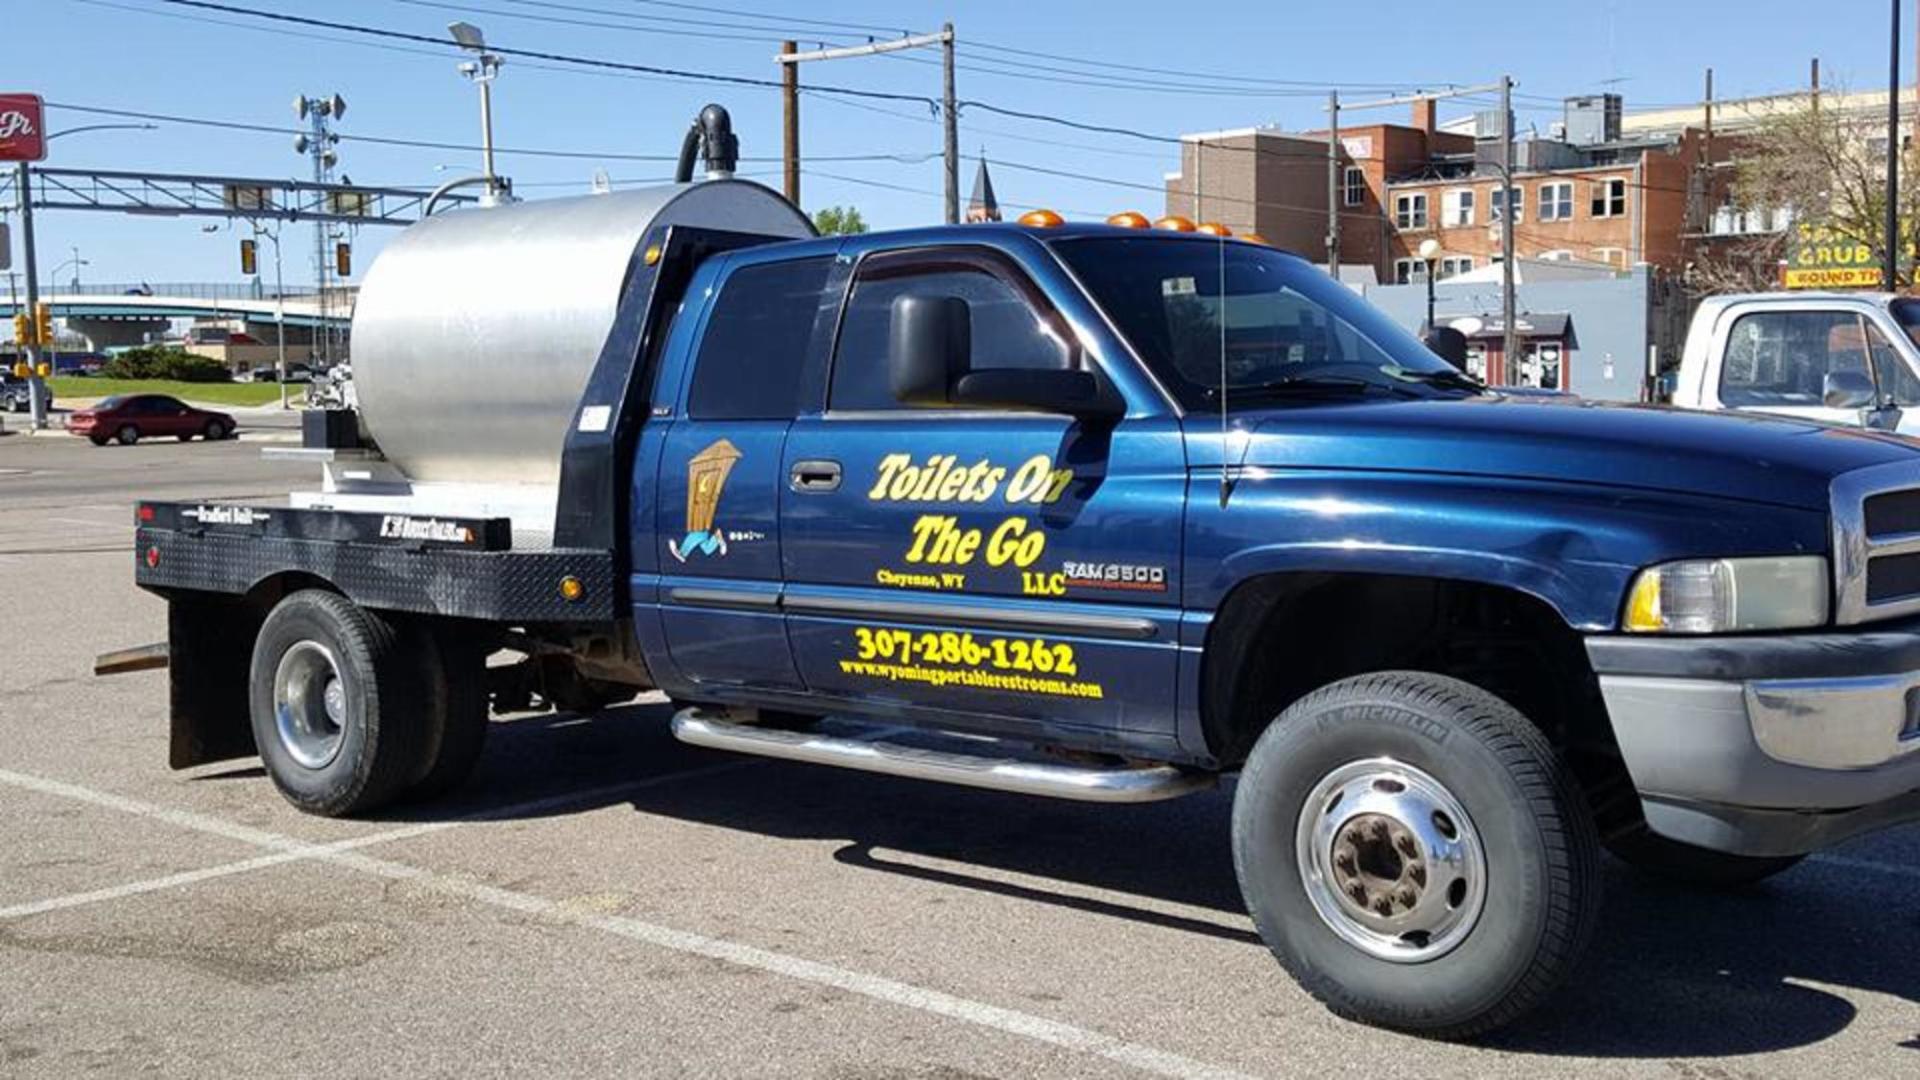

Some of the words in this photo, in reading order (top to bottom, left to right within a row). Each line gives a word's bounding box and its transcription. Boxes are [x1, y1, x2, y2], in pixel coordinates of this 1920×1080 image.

[868, 453, 1006, 502] Toilets
[1006, 454, 1074, 503] On
[905, 515, 982, 565] The
[986, 516, 1046, 568] Go
[876, 569, 940, 589] Cheyenne,
[941, 573, 965, 589] WY
[1021, 572, 1066, 595] LLC
[855, 627, 1077, 676] 307-286-1262
[839, 660, 1104, 698] www.wyomingportablerestrooms.com
[1343, 704, 1451, 746] MICHELIN
